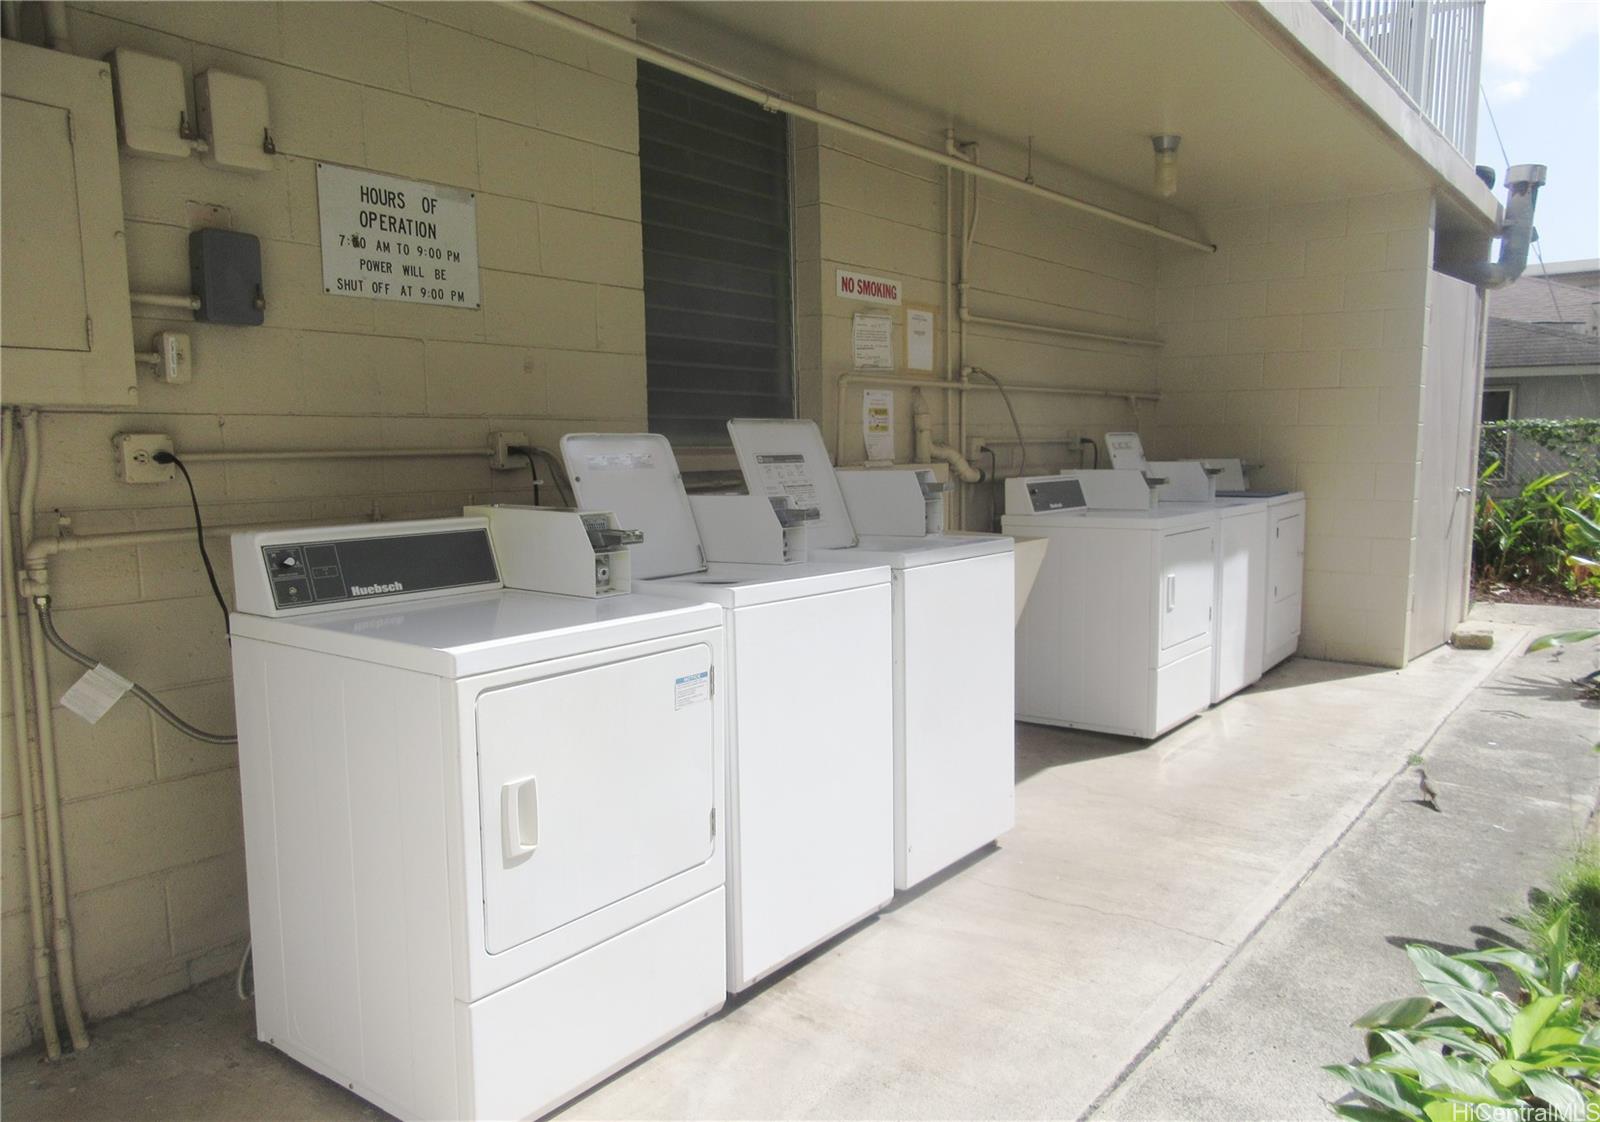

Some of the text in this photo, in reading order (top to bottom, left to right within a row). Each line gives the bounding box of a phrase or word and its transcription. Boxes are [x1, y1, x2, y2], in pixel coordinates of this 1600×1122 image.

[360, 185, 438, 215] HOURS OF
[359, 211, 437, 239] OPERATION
[339, 233, 461, 263] 7:0 AM TO 9:00 PM
[360, 258, 447, 281] POWER WILL BE
[337, 278, 465, 302] SHUT OFF AT 9:00 PM
[841, 276, 897, 300] NO SMOKING
[351, 581, 404, 596] Huebsch
